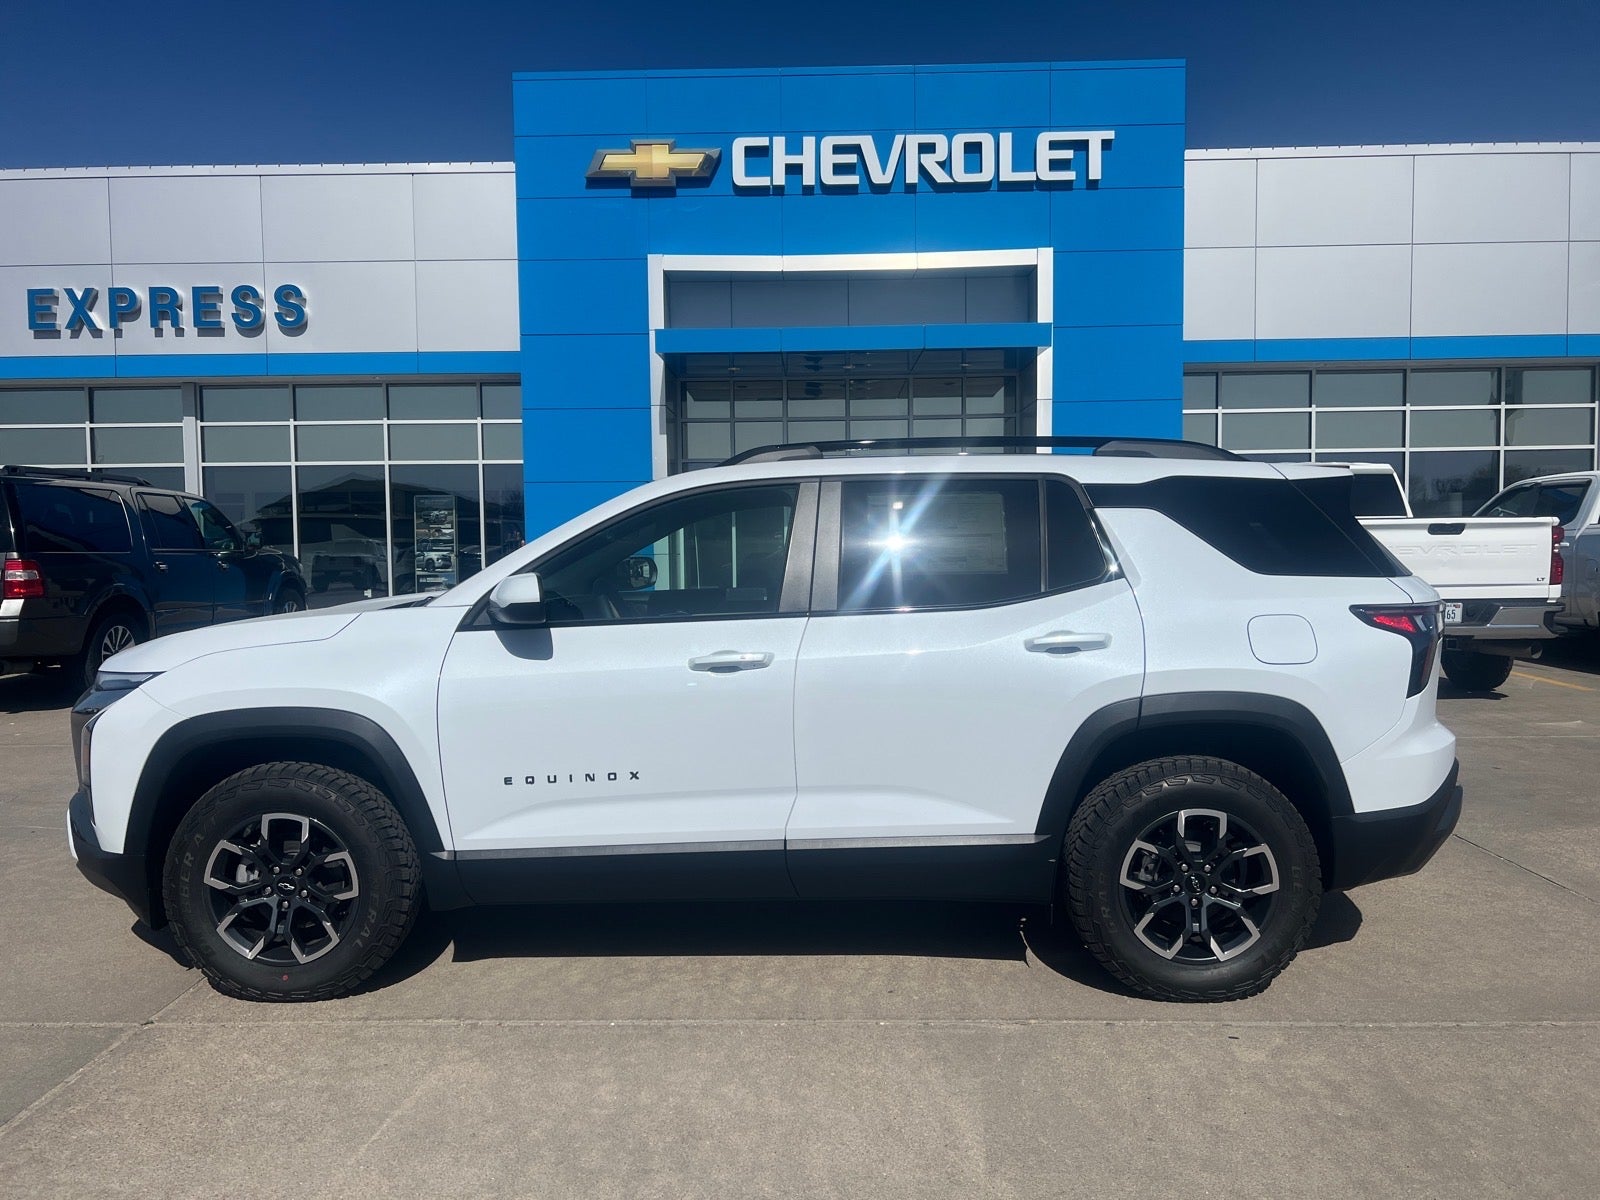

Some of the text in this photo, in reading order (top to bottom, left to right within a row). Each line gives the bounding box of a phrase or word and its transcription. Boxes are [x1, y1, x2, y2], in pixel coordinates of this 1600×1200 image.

[732, 130, 1115, 188] CHEVROLET
[27, 284, 307, 330] EXPRESS
[1395, 543, 1538, 556] EVROLET
[503, 770, 640, 786] EQUINOX
